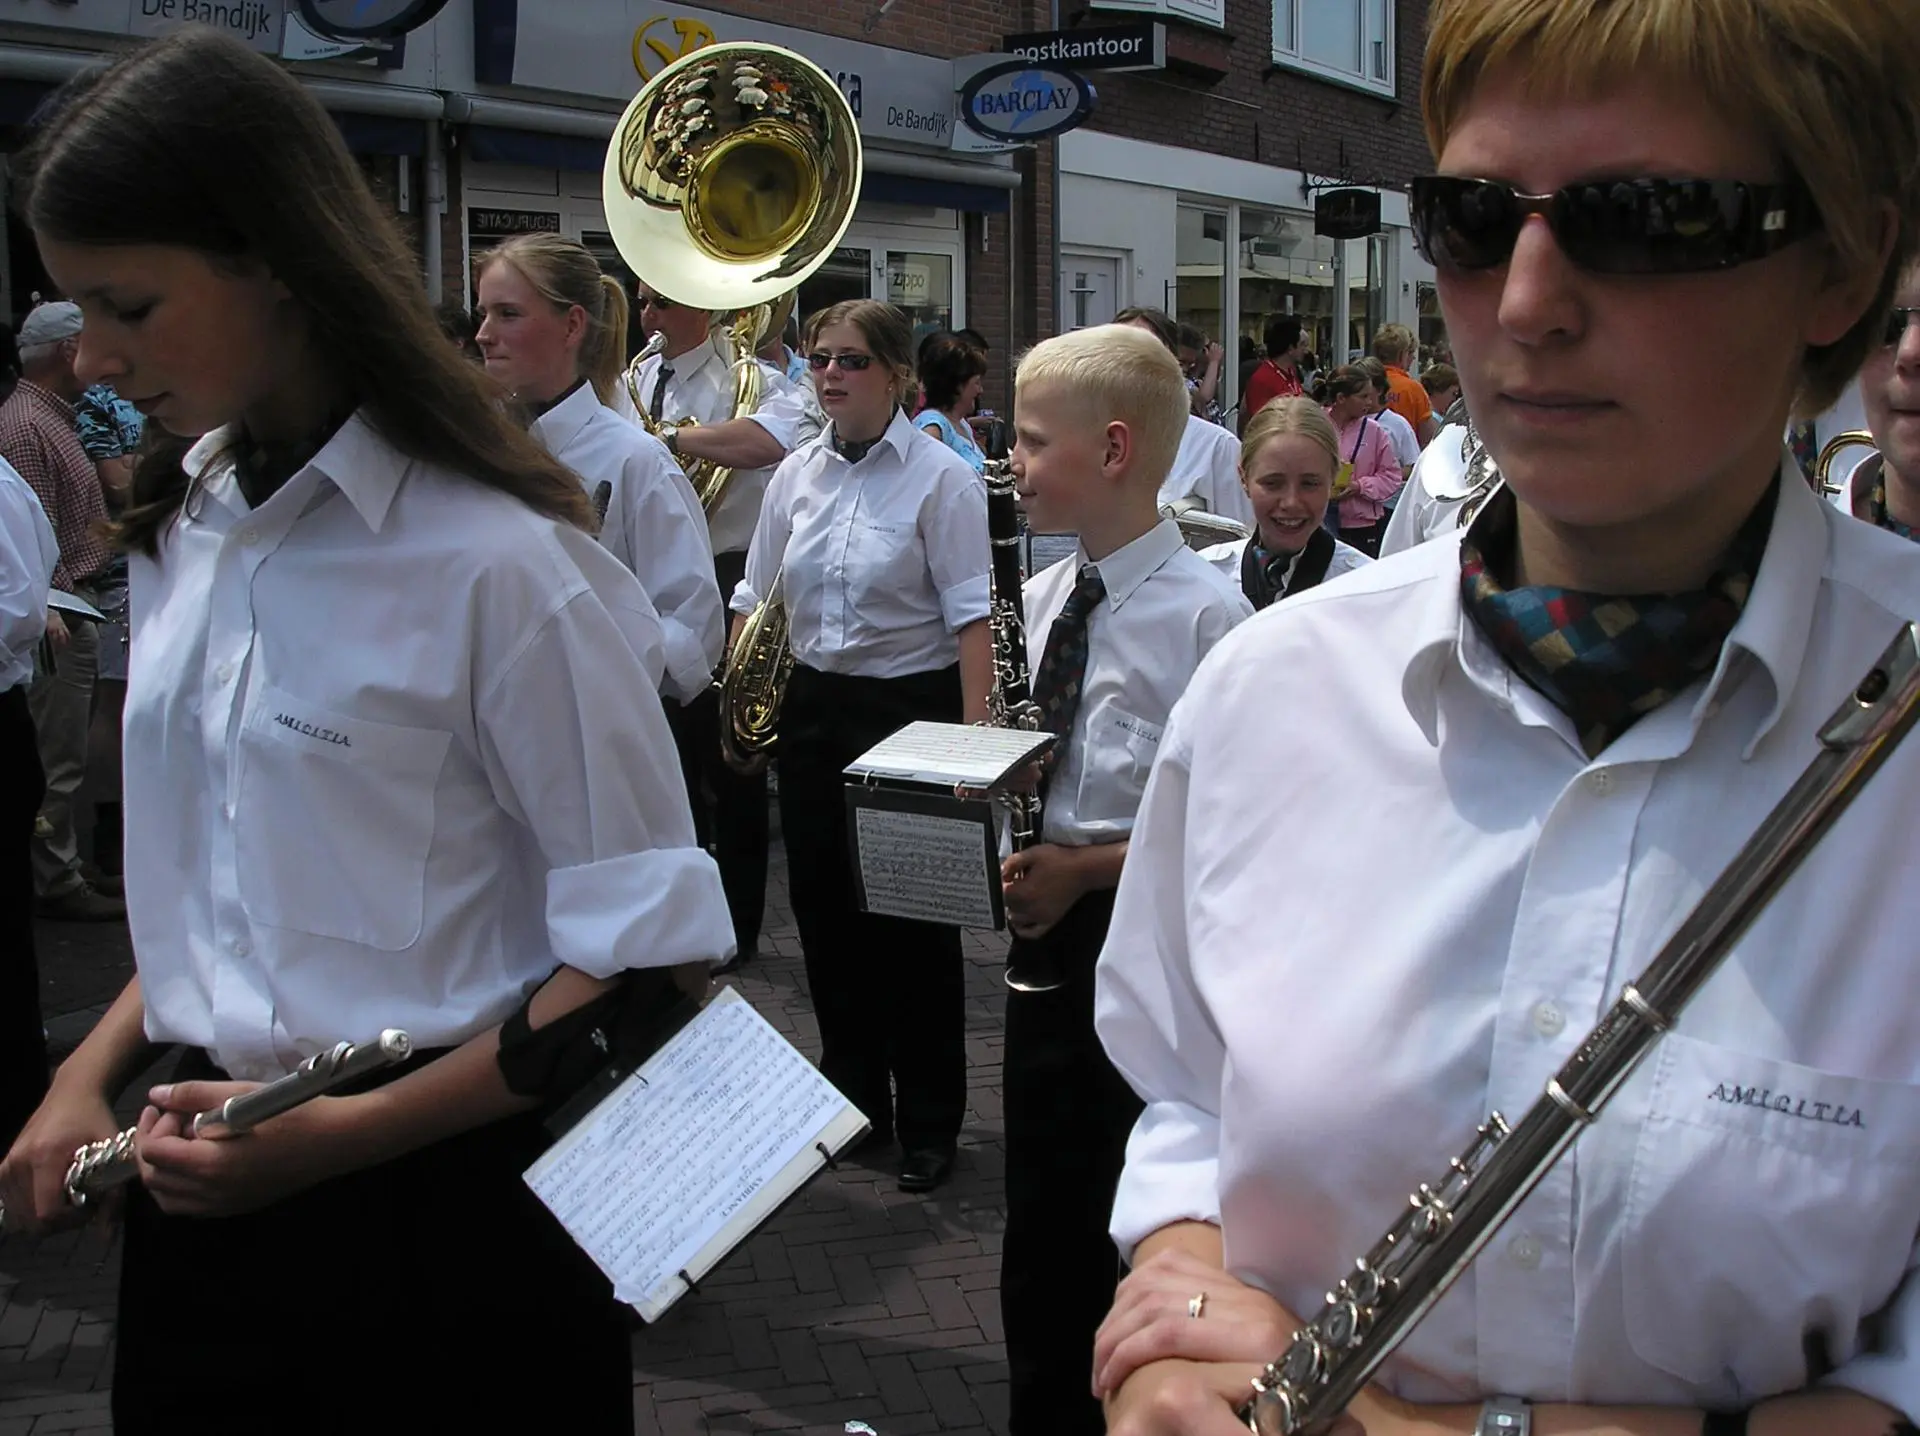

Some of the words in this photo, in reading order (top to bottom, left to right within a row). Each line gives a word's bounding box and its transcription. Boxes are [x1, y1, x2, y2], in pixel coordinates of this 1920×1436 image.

[142, 0, 176, 18] De
[183, 0, 271, 40] Bandijk
[980, 87, 1073, 115] BARCLAY
[887, 106, 904, 127] De
[905, 109, 949, 138] Bandijk
[274, 713, 351, 747] AMICITIA
[1708, 1082, 1866, 1129] AMICITIA
